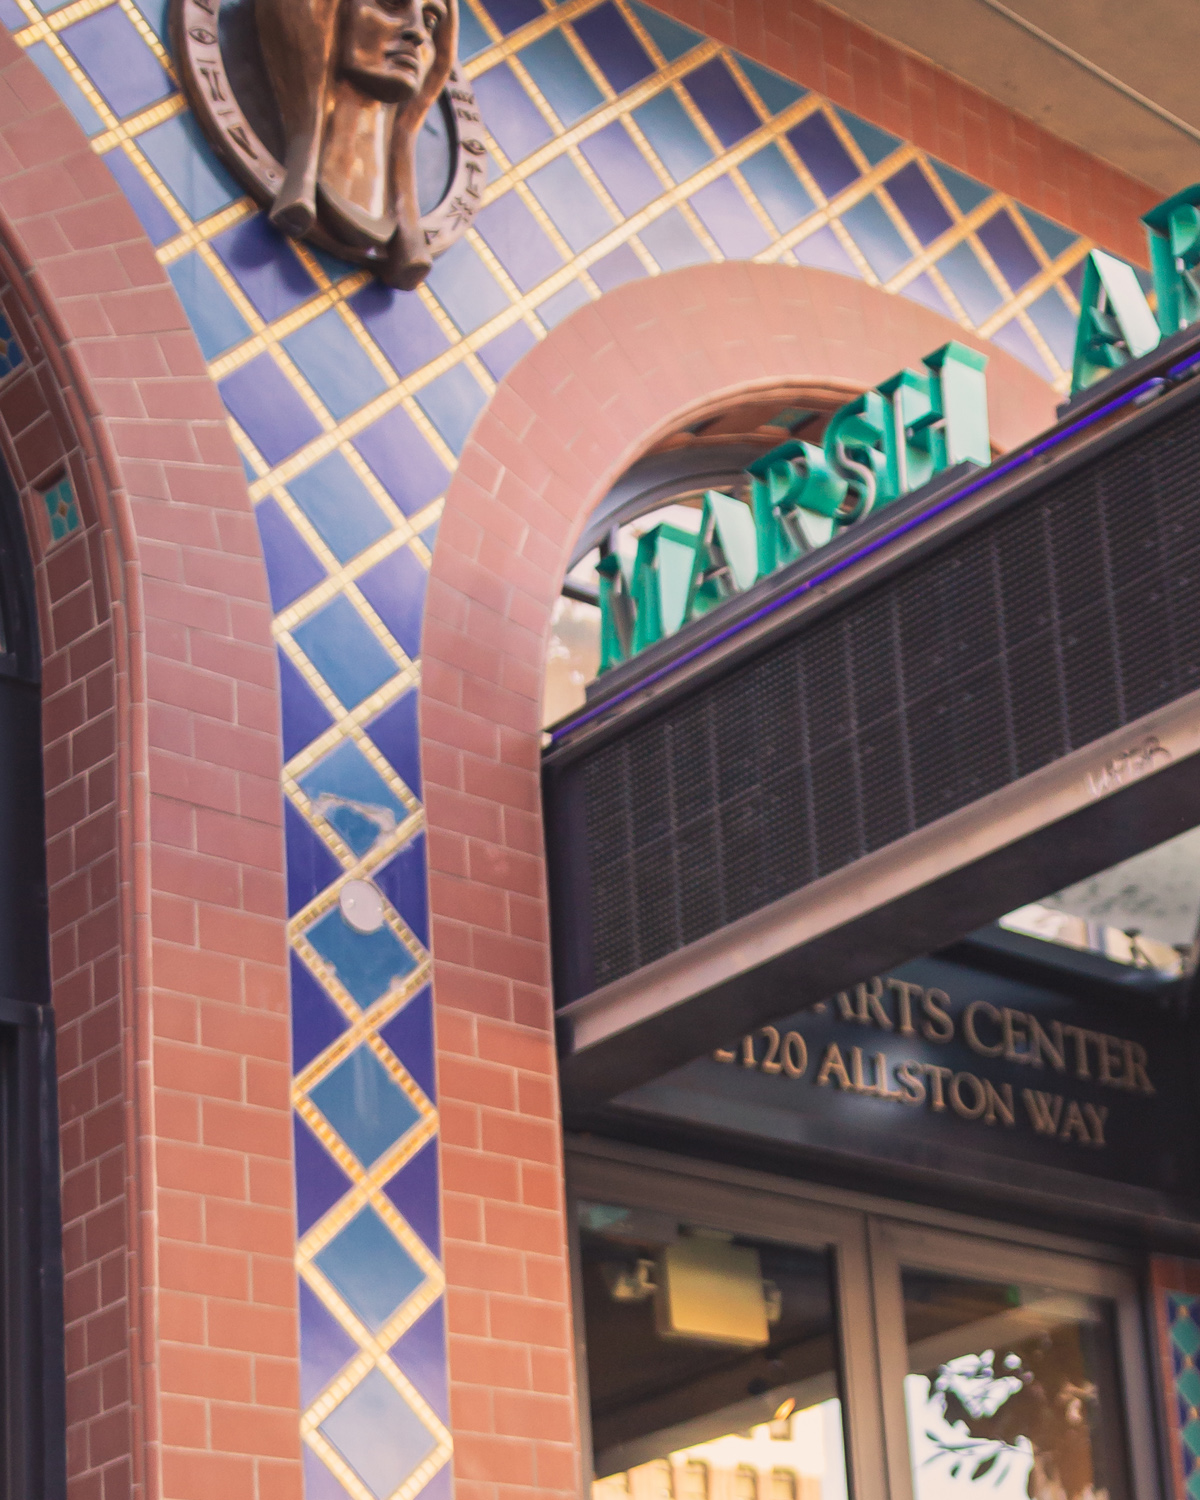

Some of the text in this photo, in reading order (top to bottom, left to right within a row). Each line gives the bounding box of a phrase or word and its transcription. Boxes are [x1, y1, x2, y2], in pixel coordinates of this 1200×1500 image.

[596, 340, 992, 677] MARSH
[816, 1042, 1016, 1127] ALLSTON
[1022, 1088, 1108, 1146] WAY
[963, 999, 1156, 1094] CENTER
